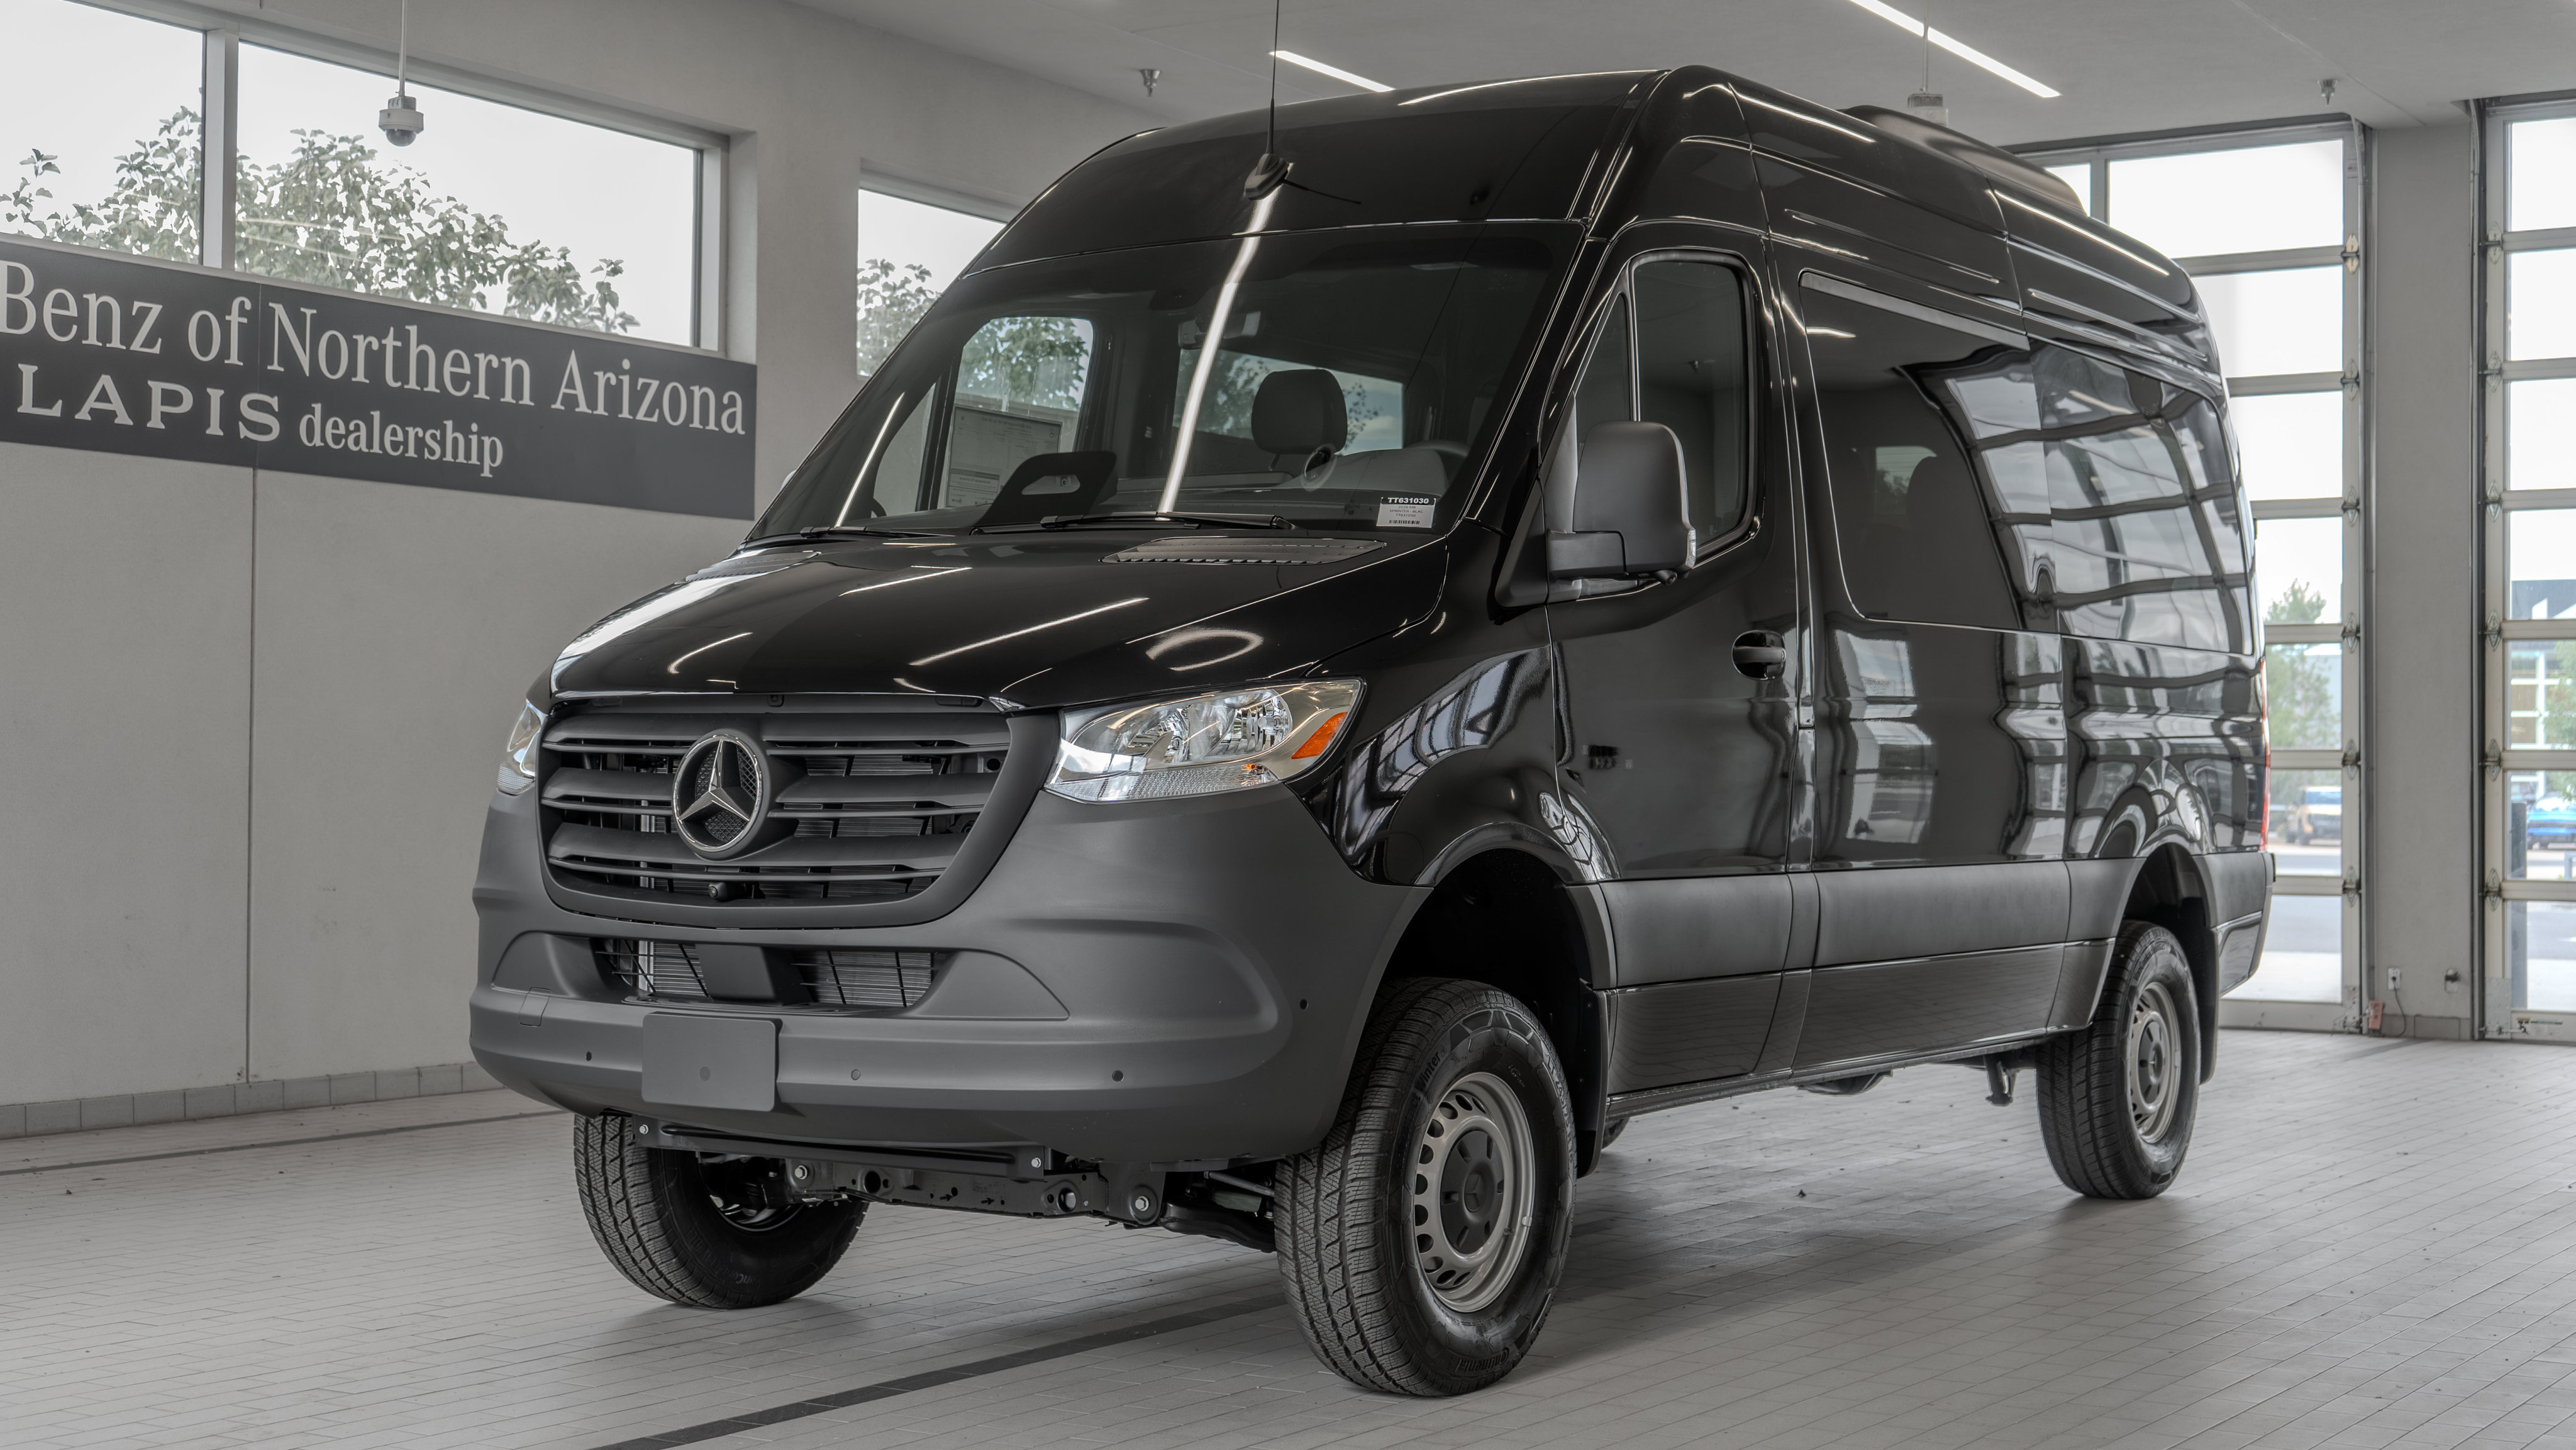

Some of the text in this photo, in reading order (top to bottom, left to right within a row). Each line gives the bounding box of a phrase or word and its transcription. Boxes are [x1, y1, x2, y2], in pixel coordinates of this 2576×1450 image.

[0, 260, 745, 435] Benz of Northern Arizona
[17, 363, 503, 477] LAPIS dealership
[1416, 1051, 1440, 1093] Winter
[1454, 1347, 1509, 1373] Continental
